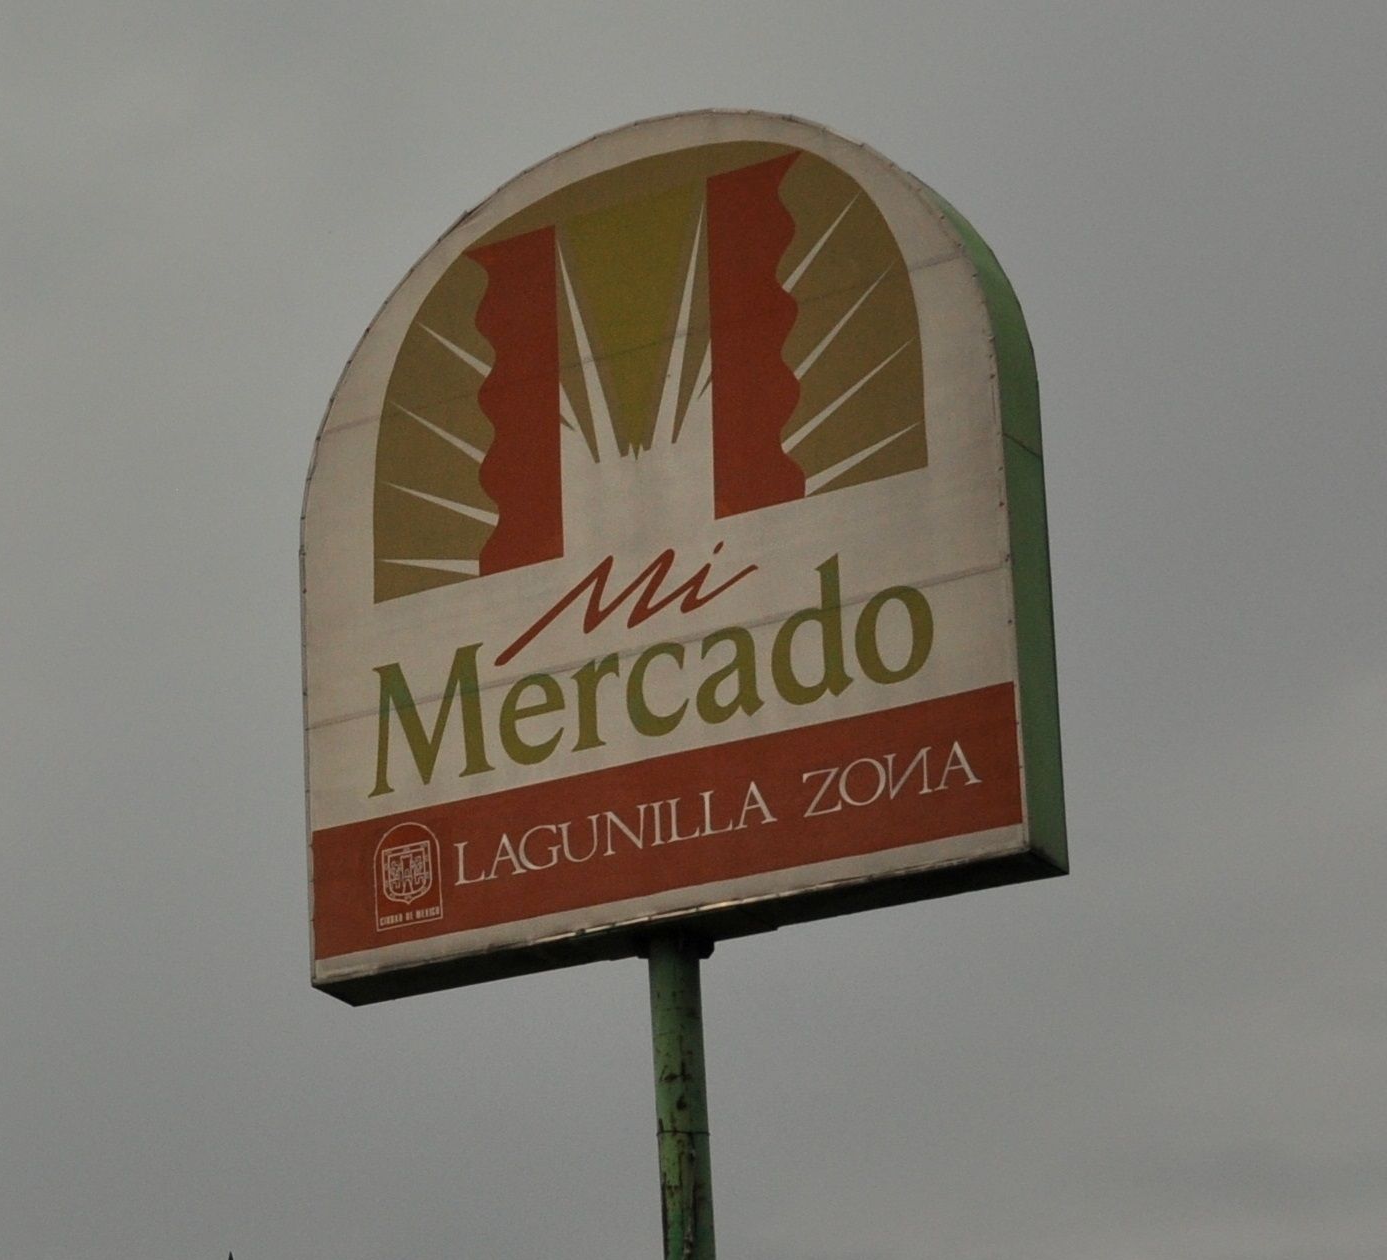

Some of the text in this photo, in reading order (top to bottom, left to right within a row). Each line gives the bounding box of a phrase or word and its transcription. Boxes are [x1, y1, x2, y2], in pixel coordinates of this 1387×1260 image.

[494, 540, 759, 666] Mi
[368, 555, 935, 799] Mercado
[453, 780, 778, 886] LAGUNILLA
